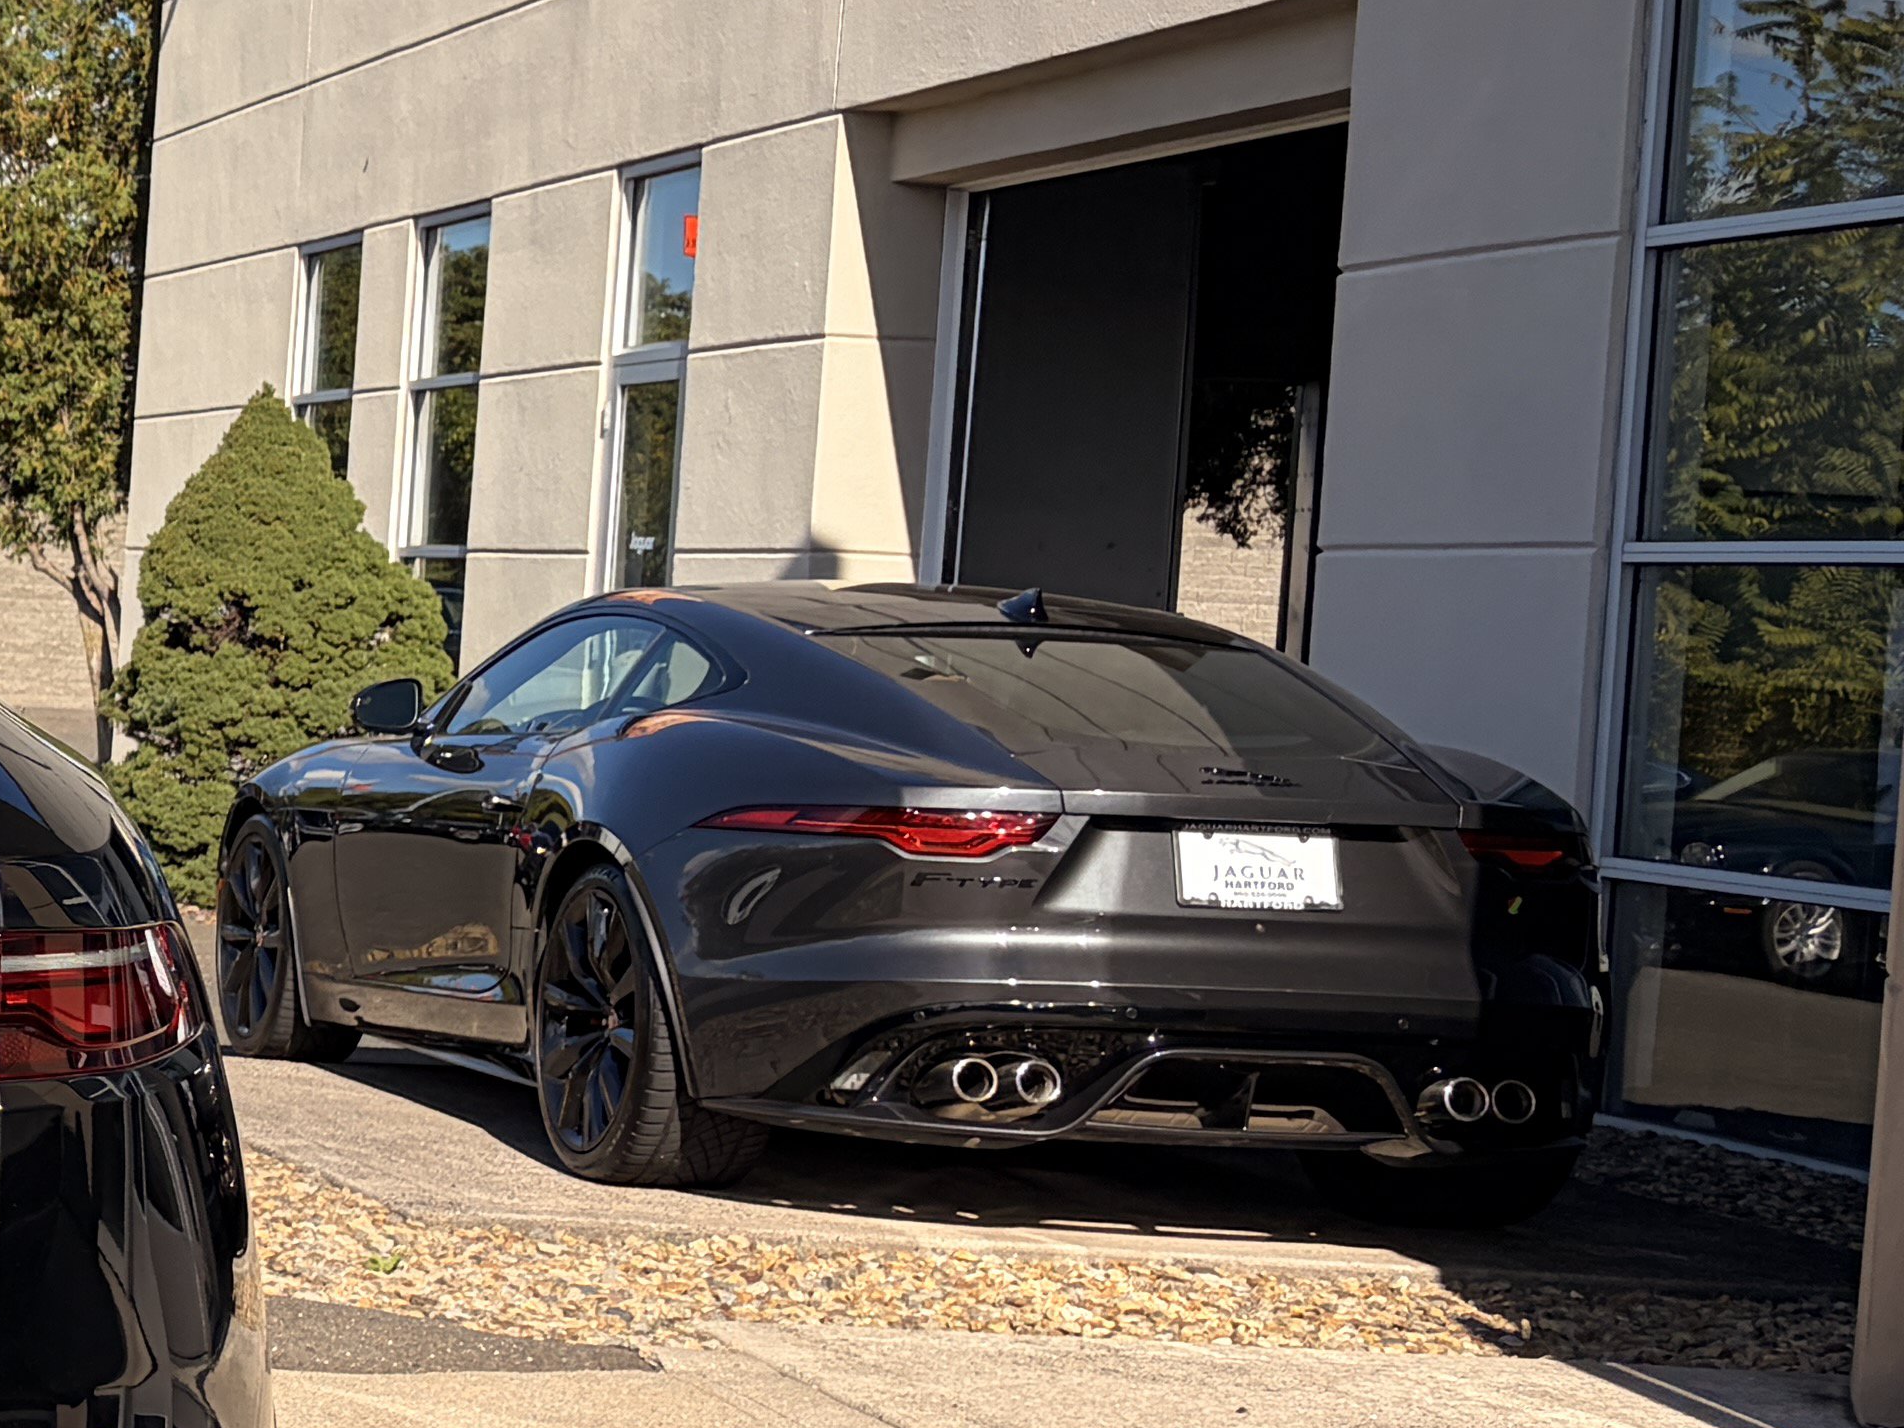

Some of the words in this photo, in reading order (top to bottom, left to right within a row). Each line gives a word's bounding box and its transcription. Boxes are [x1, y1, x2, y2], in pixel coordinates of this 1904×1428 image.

[910, 872, 1039, 889] F-TYPE
[1213, 864, 1305, 882] JAGUAR
[1224, 879, 1295, 891] HARTFORD
